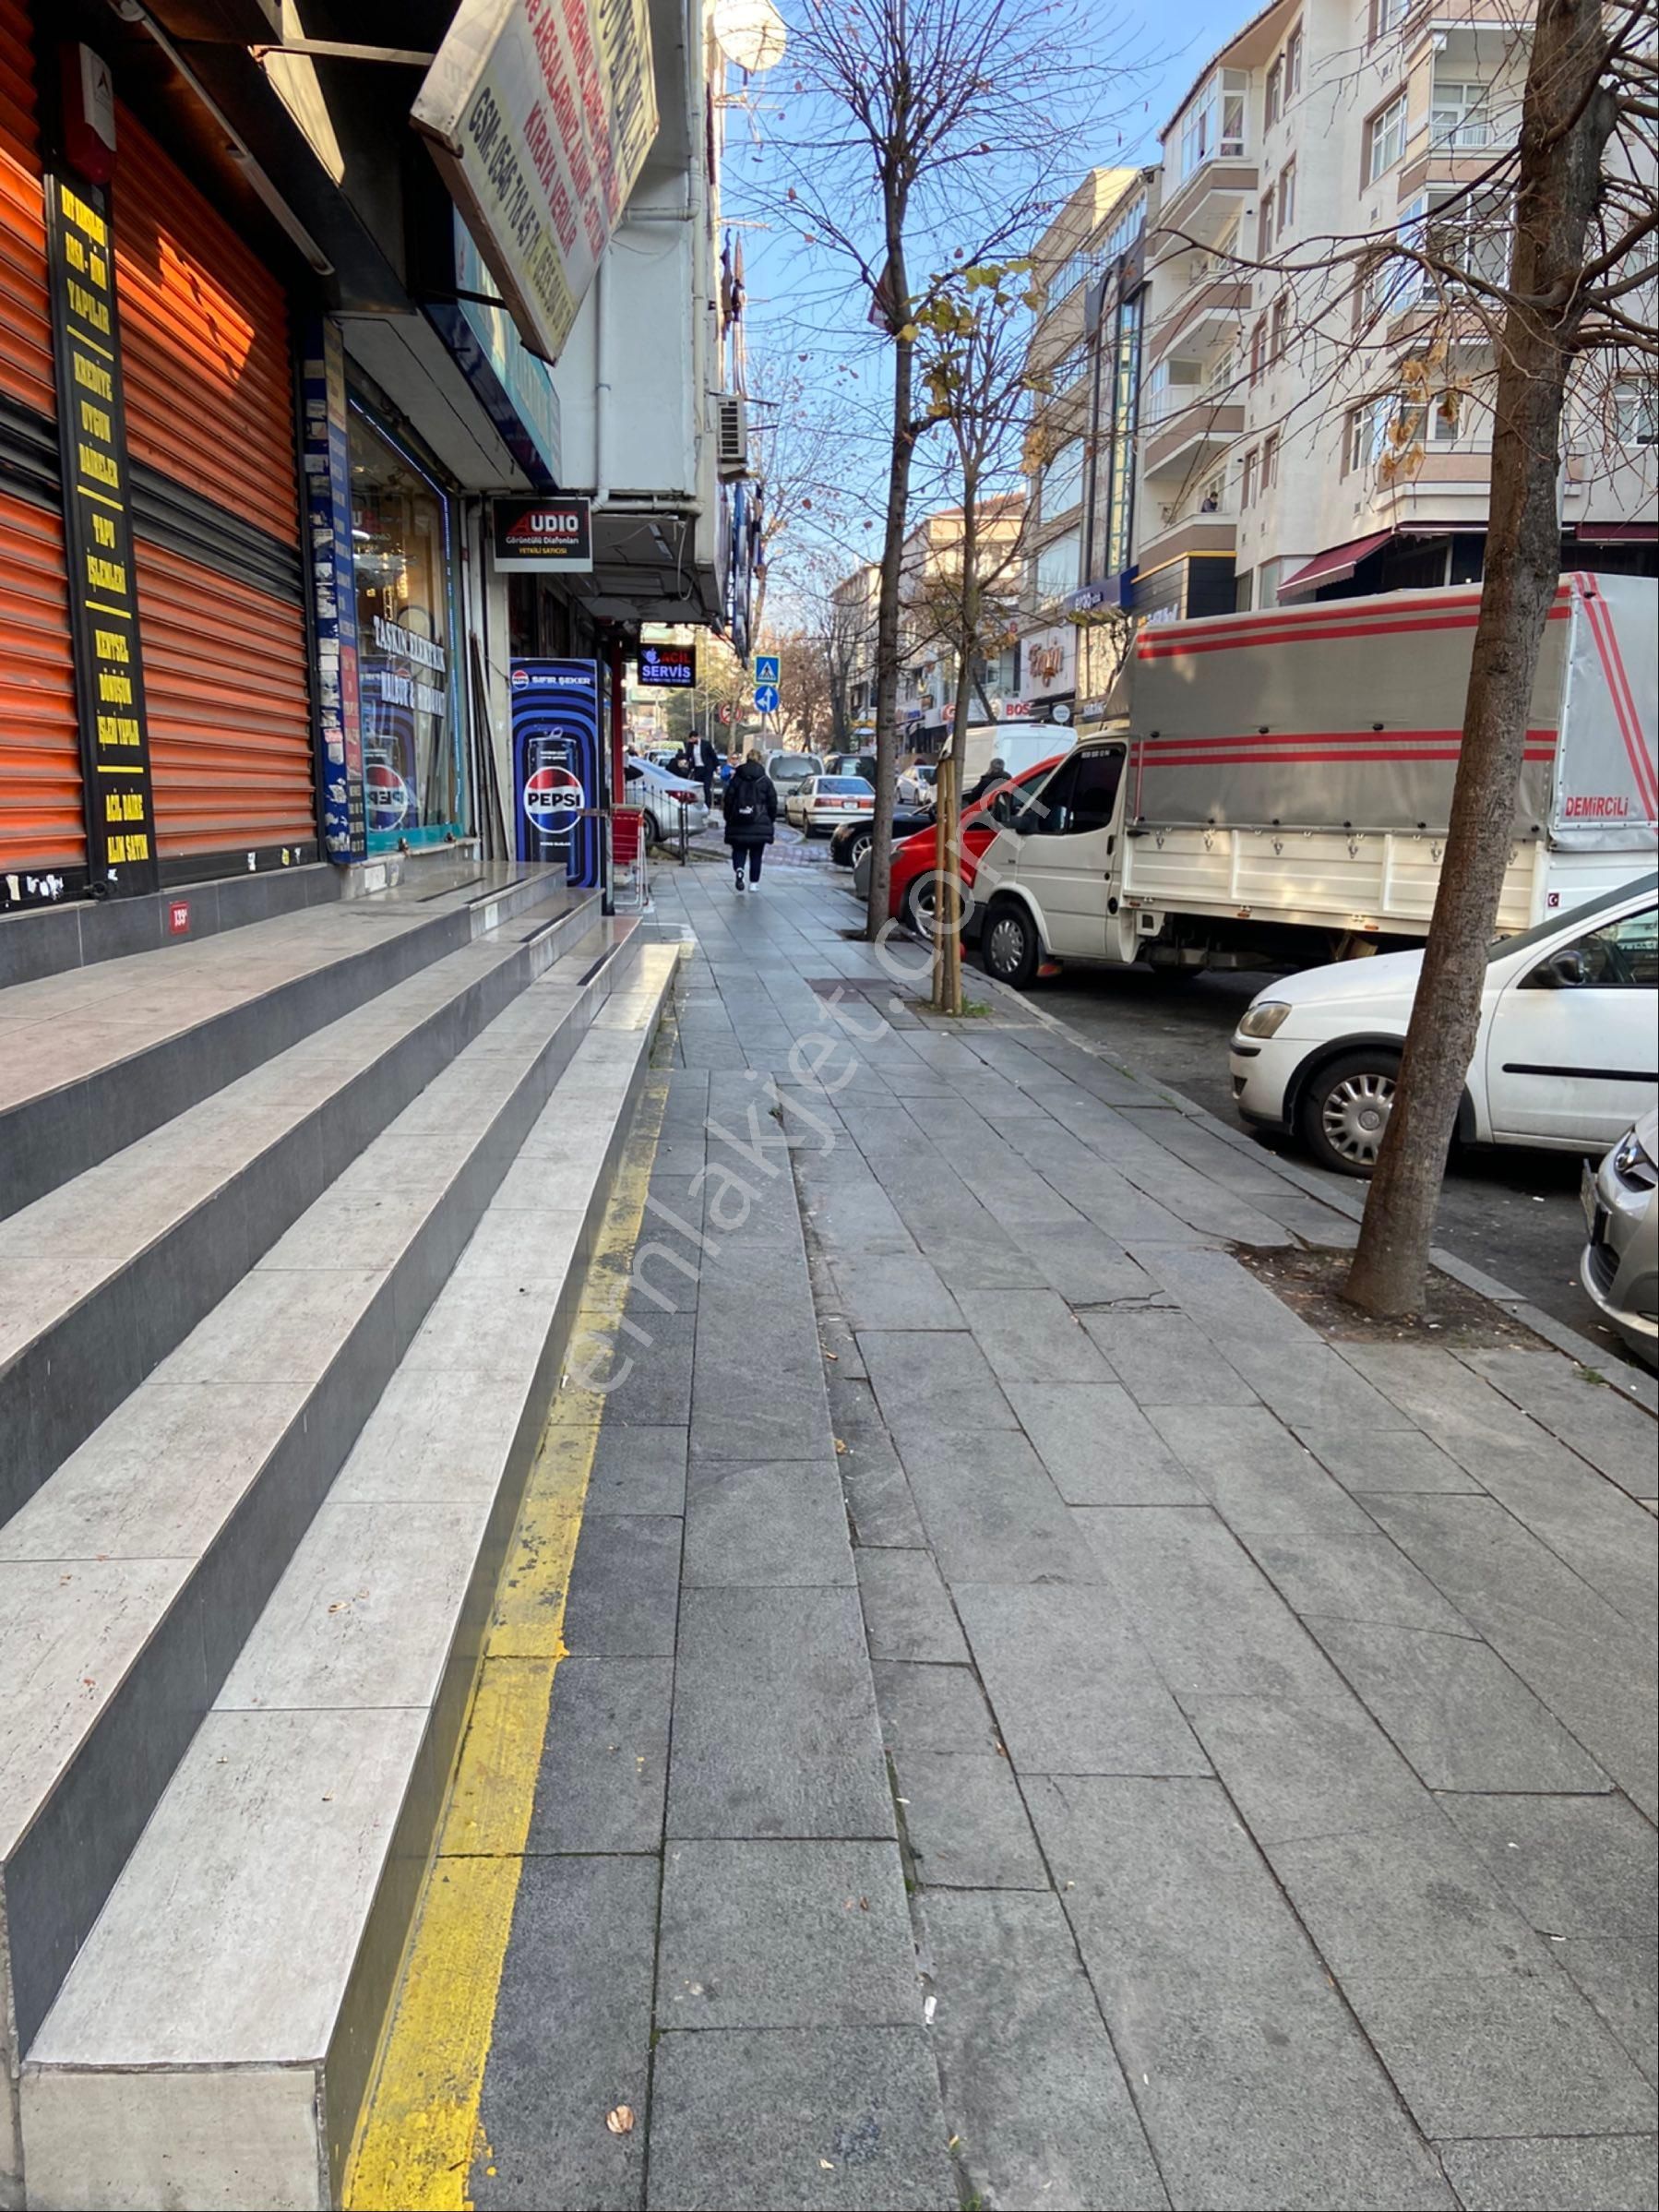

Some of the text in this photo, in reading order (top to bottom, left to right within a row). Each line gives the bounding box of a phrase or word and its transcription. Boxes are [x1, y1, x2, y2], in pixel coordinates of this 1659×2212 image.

[532, 8, 579, 152] ARSALARINIZ
[567, 138, 591, 204] ALINIR
[468, 87, 501, 162] GSM:
[487, 134, 518, 201] 0546
[503, 173, 529, 229] 718
[516, 204, 536, 247] 45
[522, 101, 577, 257] KİRAYA VERİLİR
[66, 277, 110, 336] YAPILIR
[558, 676, 591, 687] ŞEKER
[642, 664, 691, 678] SERVİS
[1006, 703, 1032, 715] BOS
[528, 792, 581, 807] PEPSI
